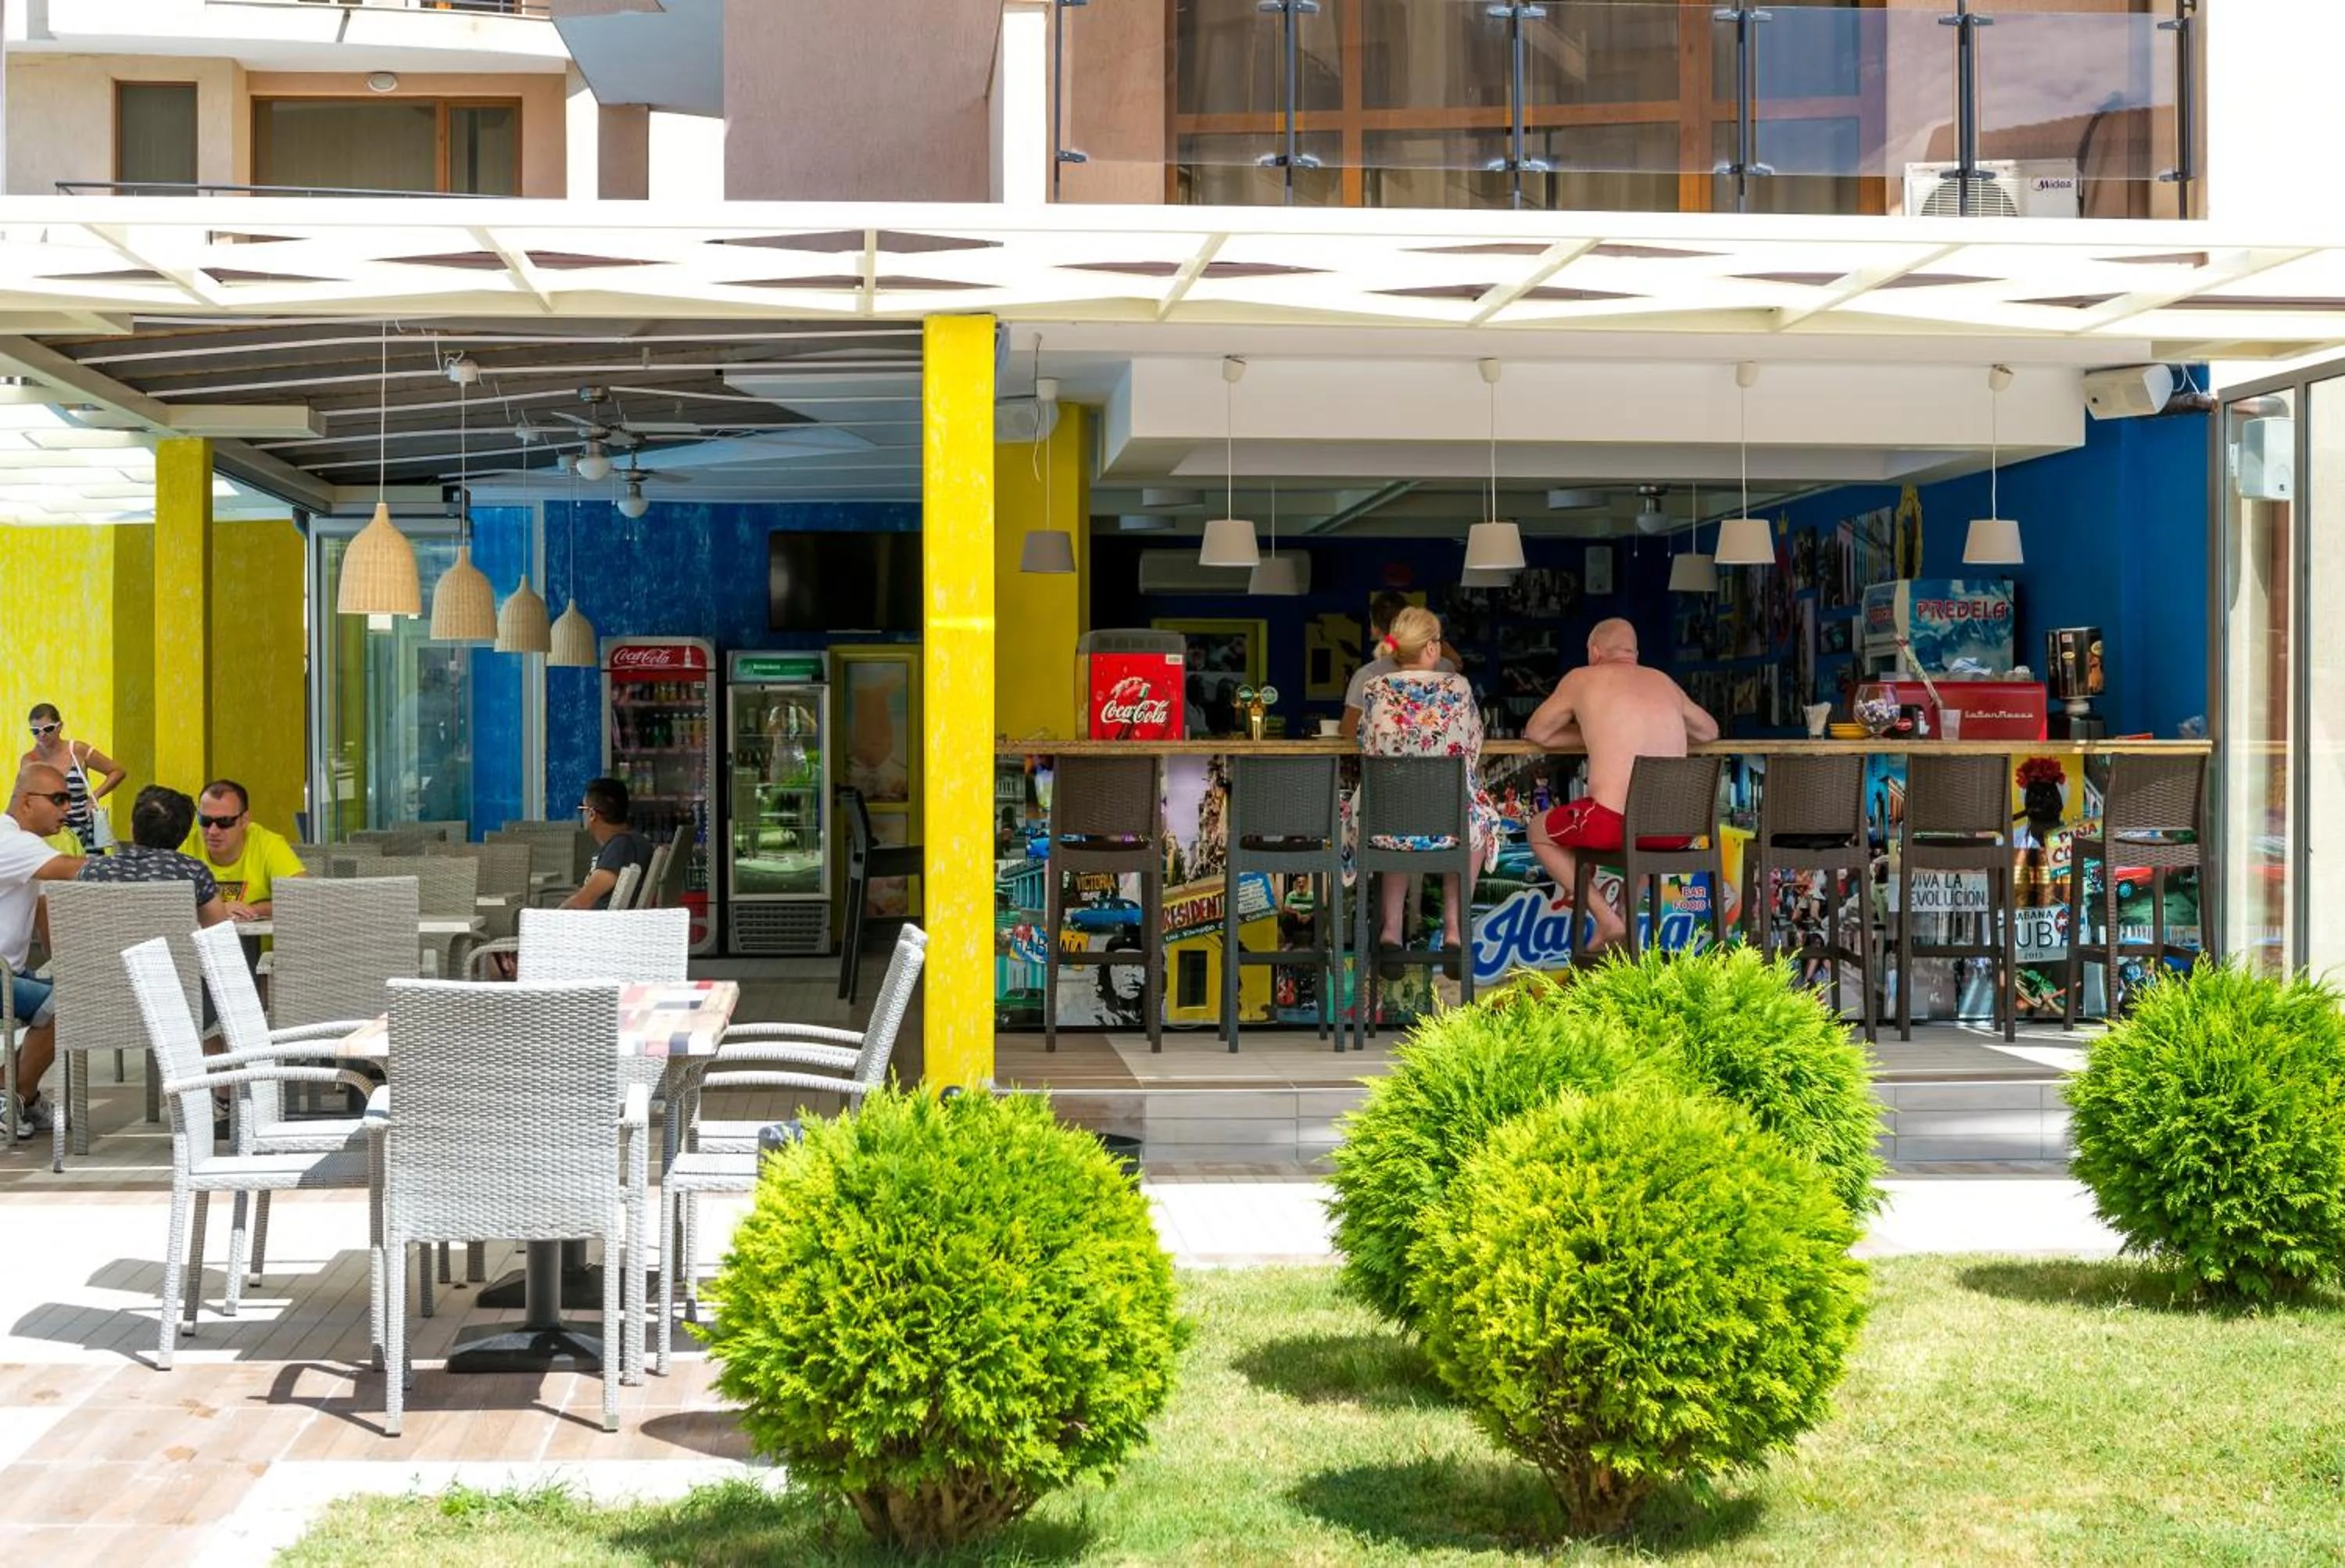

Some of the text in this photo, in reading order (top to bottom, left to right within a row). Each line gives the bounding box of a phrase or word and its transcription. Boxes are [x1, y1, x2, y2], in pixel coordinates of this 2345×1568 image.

[2037, 179, 2071, 189] Midea
[1917, 600, 2007, 621] PREDELA
[614, 648, 671, 664] Coca-Cola
[1101, 700, 1169, 724] Coca-Cola
[1076, 875, 1116, 890] VICTORIA
[1911, 873, 1962, 888] VIVA LA
[1682, 886, 1706, 897] BAR
[1911, 886, 1989, 906] EVOLUCIÓN.
[2016, 909, 2053, 921] ABANA
[2014, 921, 2070, 948] UBA
